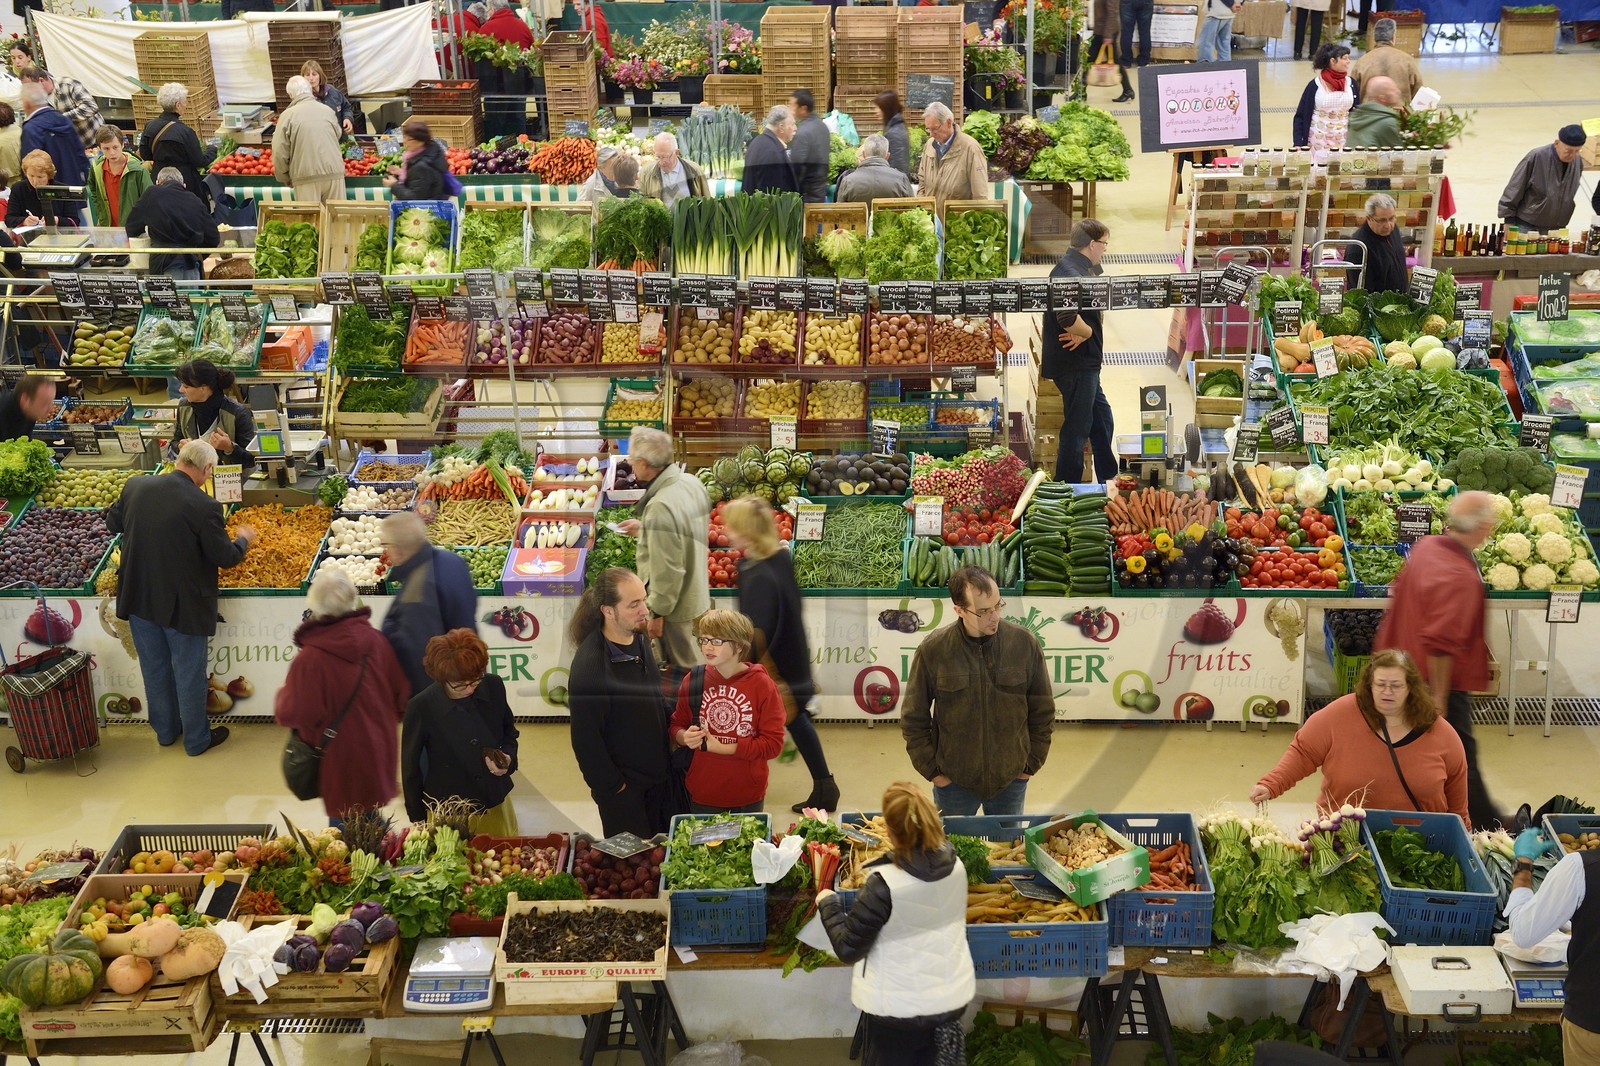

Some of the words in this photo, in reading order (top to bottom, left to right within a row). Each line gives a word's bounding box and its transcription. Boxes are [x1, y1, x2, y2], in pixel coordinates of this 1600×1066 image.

[1232, 270, 1248, 280] France
[1224, 288, 1240, 296] France
[1559, 466, 1584, 474] PROMOTION
[808, 646, 879, 665] umes
[1157, 641, 1252, 684] fruits
[1213, 668, 1290, 695] qualité
[606, 968, 657, 976] QUALITY
